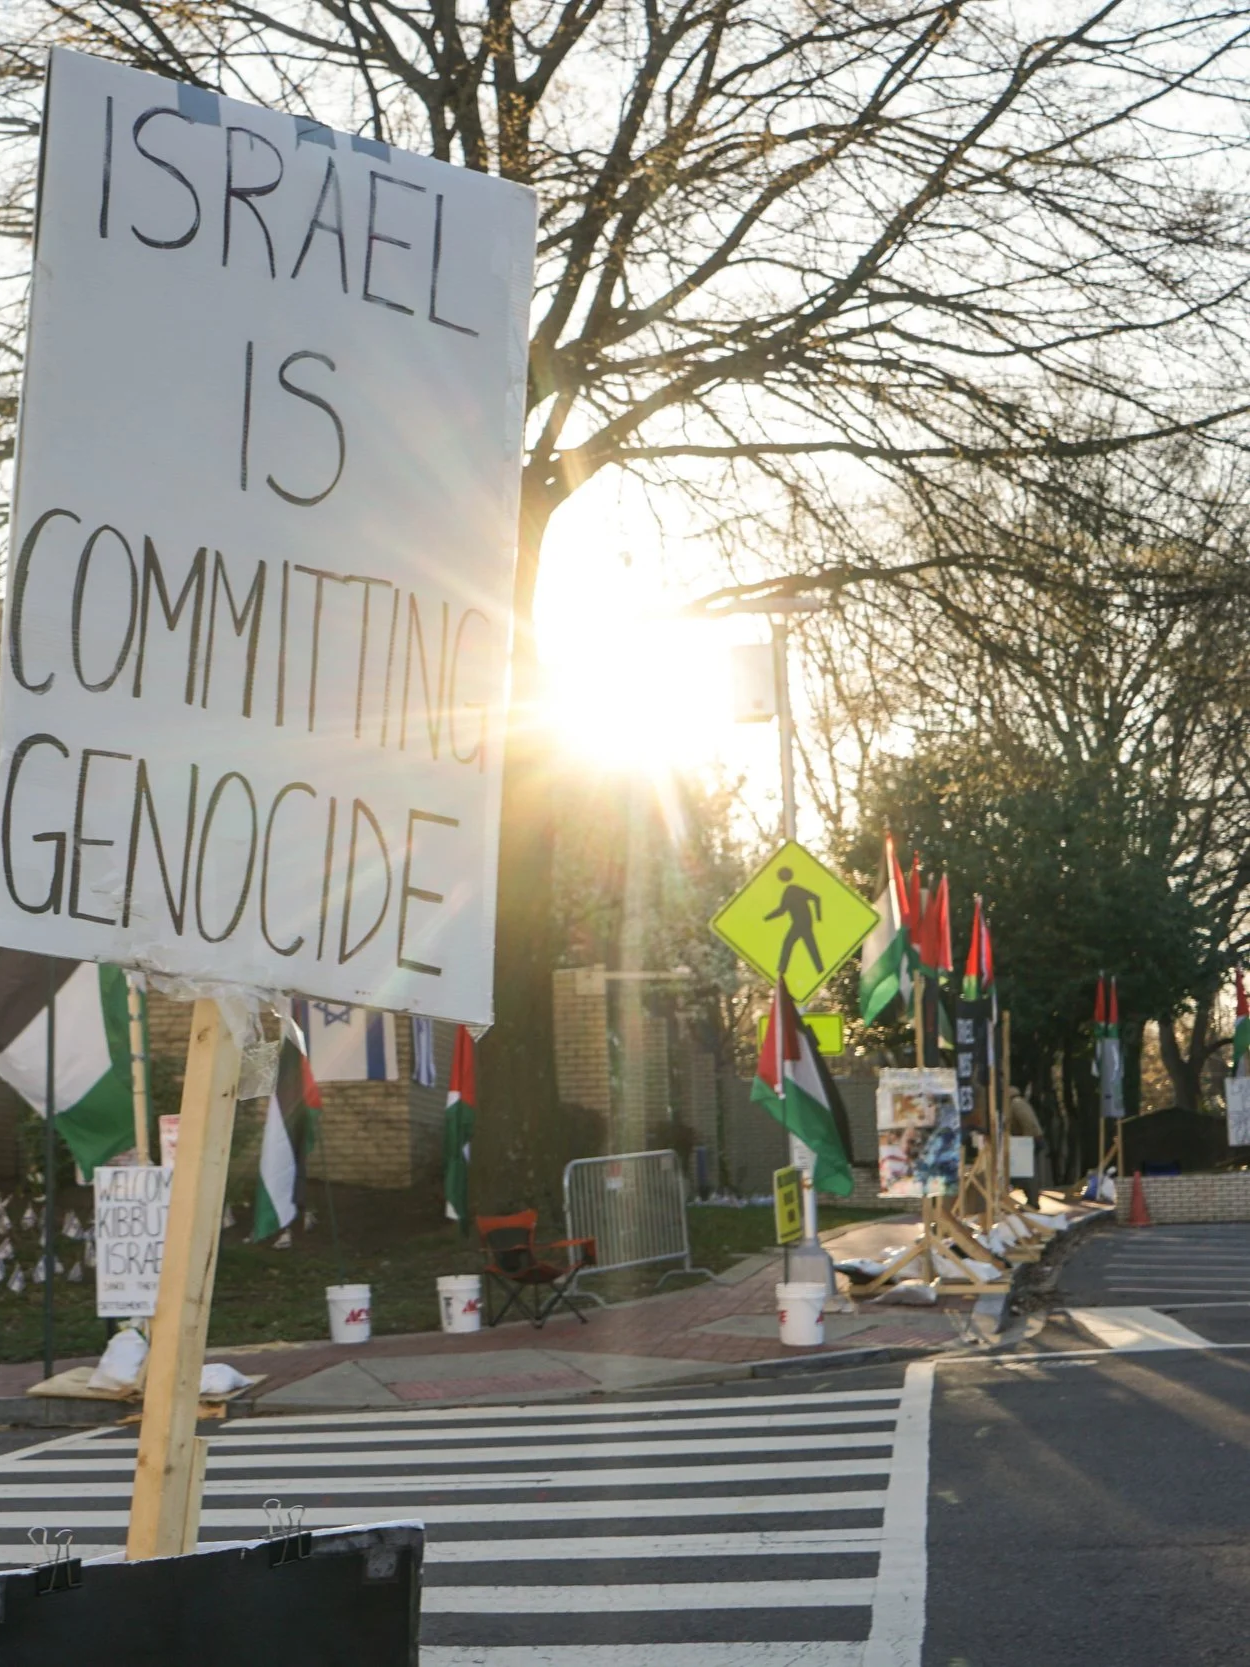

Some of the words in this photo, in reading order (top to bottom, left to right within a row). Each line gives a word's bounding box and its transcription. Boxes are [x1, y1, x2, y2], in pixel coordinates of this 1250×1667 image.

[98, 96, 479, 338] ISRAEL
[239, 340, 347, 508] IS
[9, 508, 490, 774] COMMITTING
[1, 732, 460, 976] GENOCIDE
[96, 1169, 174, 1205] WELCOM
[105, 1241, 163, 1276] ISRAE
